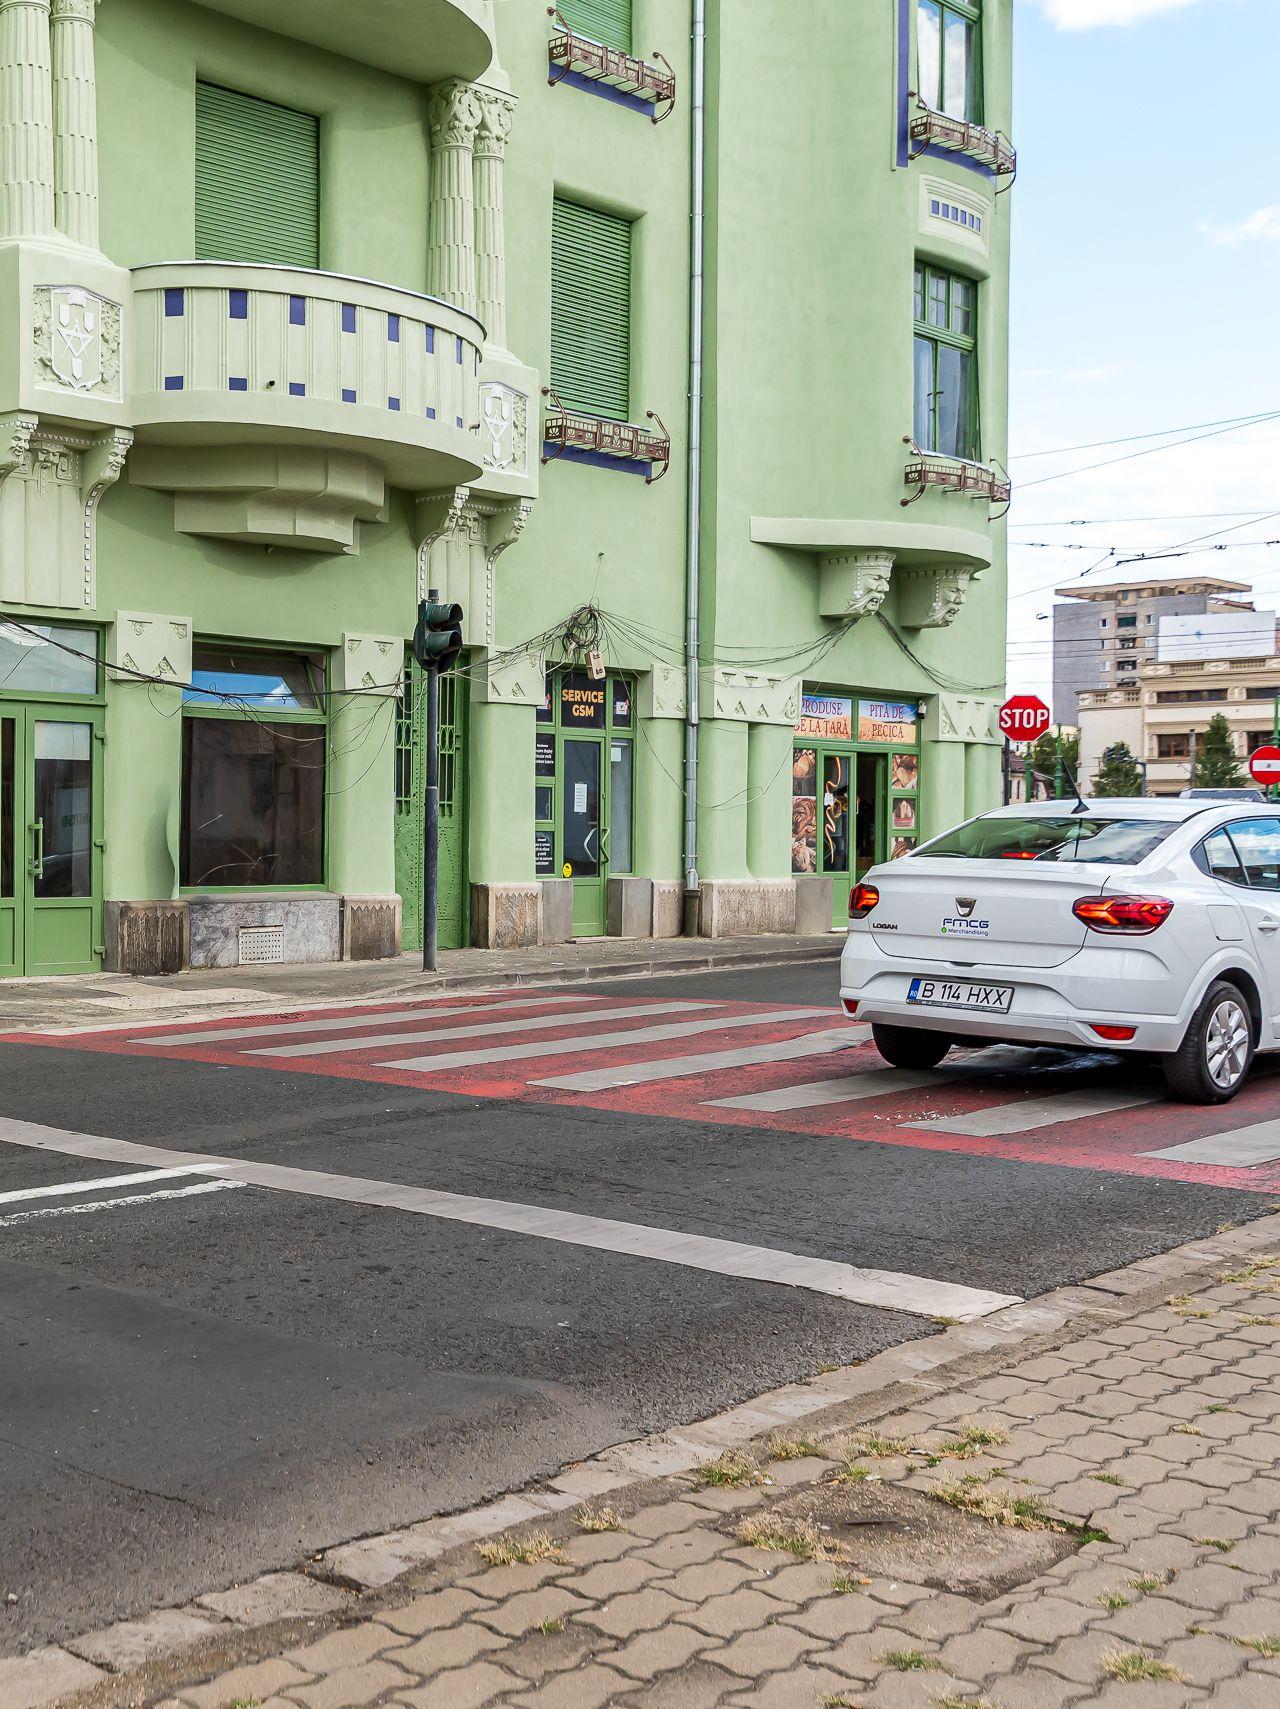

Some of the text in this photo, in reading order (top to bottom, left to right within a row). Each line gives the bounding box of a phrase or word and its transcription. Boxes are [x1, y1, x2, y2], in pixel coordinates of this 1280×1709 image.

[562, 689, 605, 703] SERVICE
[572, 704, 594, 717] GSM
[801, 698, 843, 715] PRODUSE
[892, 706, 904, 719] DE
[1000, 708, 1049, 728] STOP
[810, 719, 821, 733] LA
[872, 724, 904, 738] PECICA
[873, 922, 898, 930] LOGAN
[943, 918, 989, 929] FMCG
[948, 928, 989, 936] Merchandising
[922, 983, 1007, 1005] B 114 HXX
